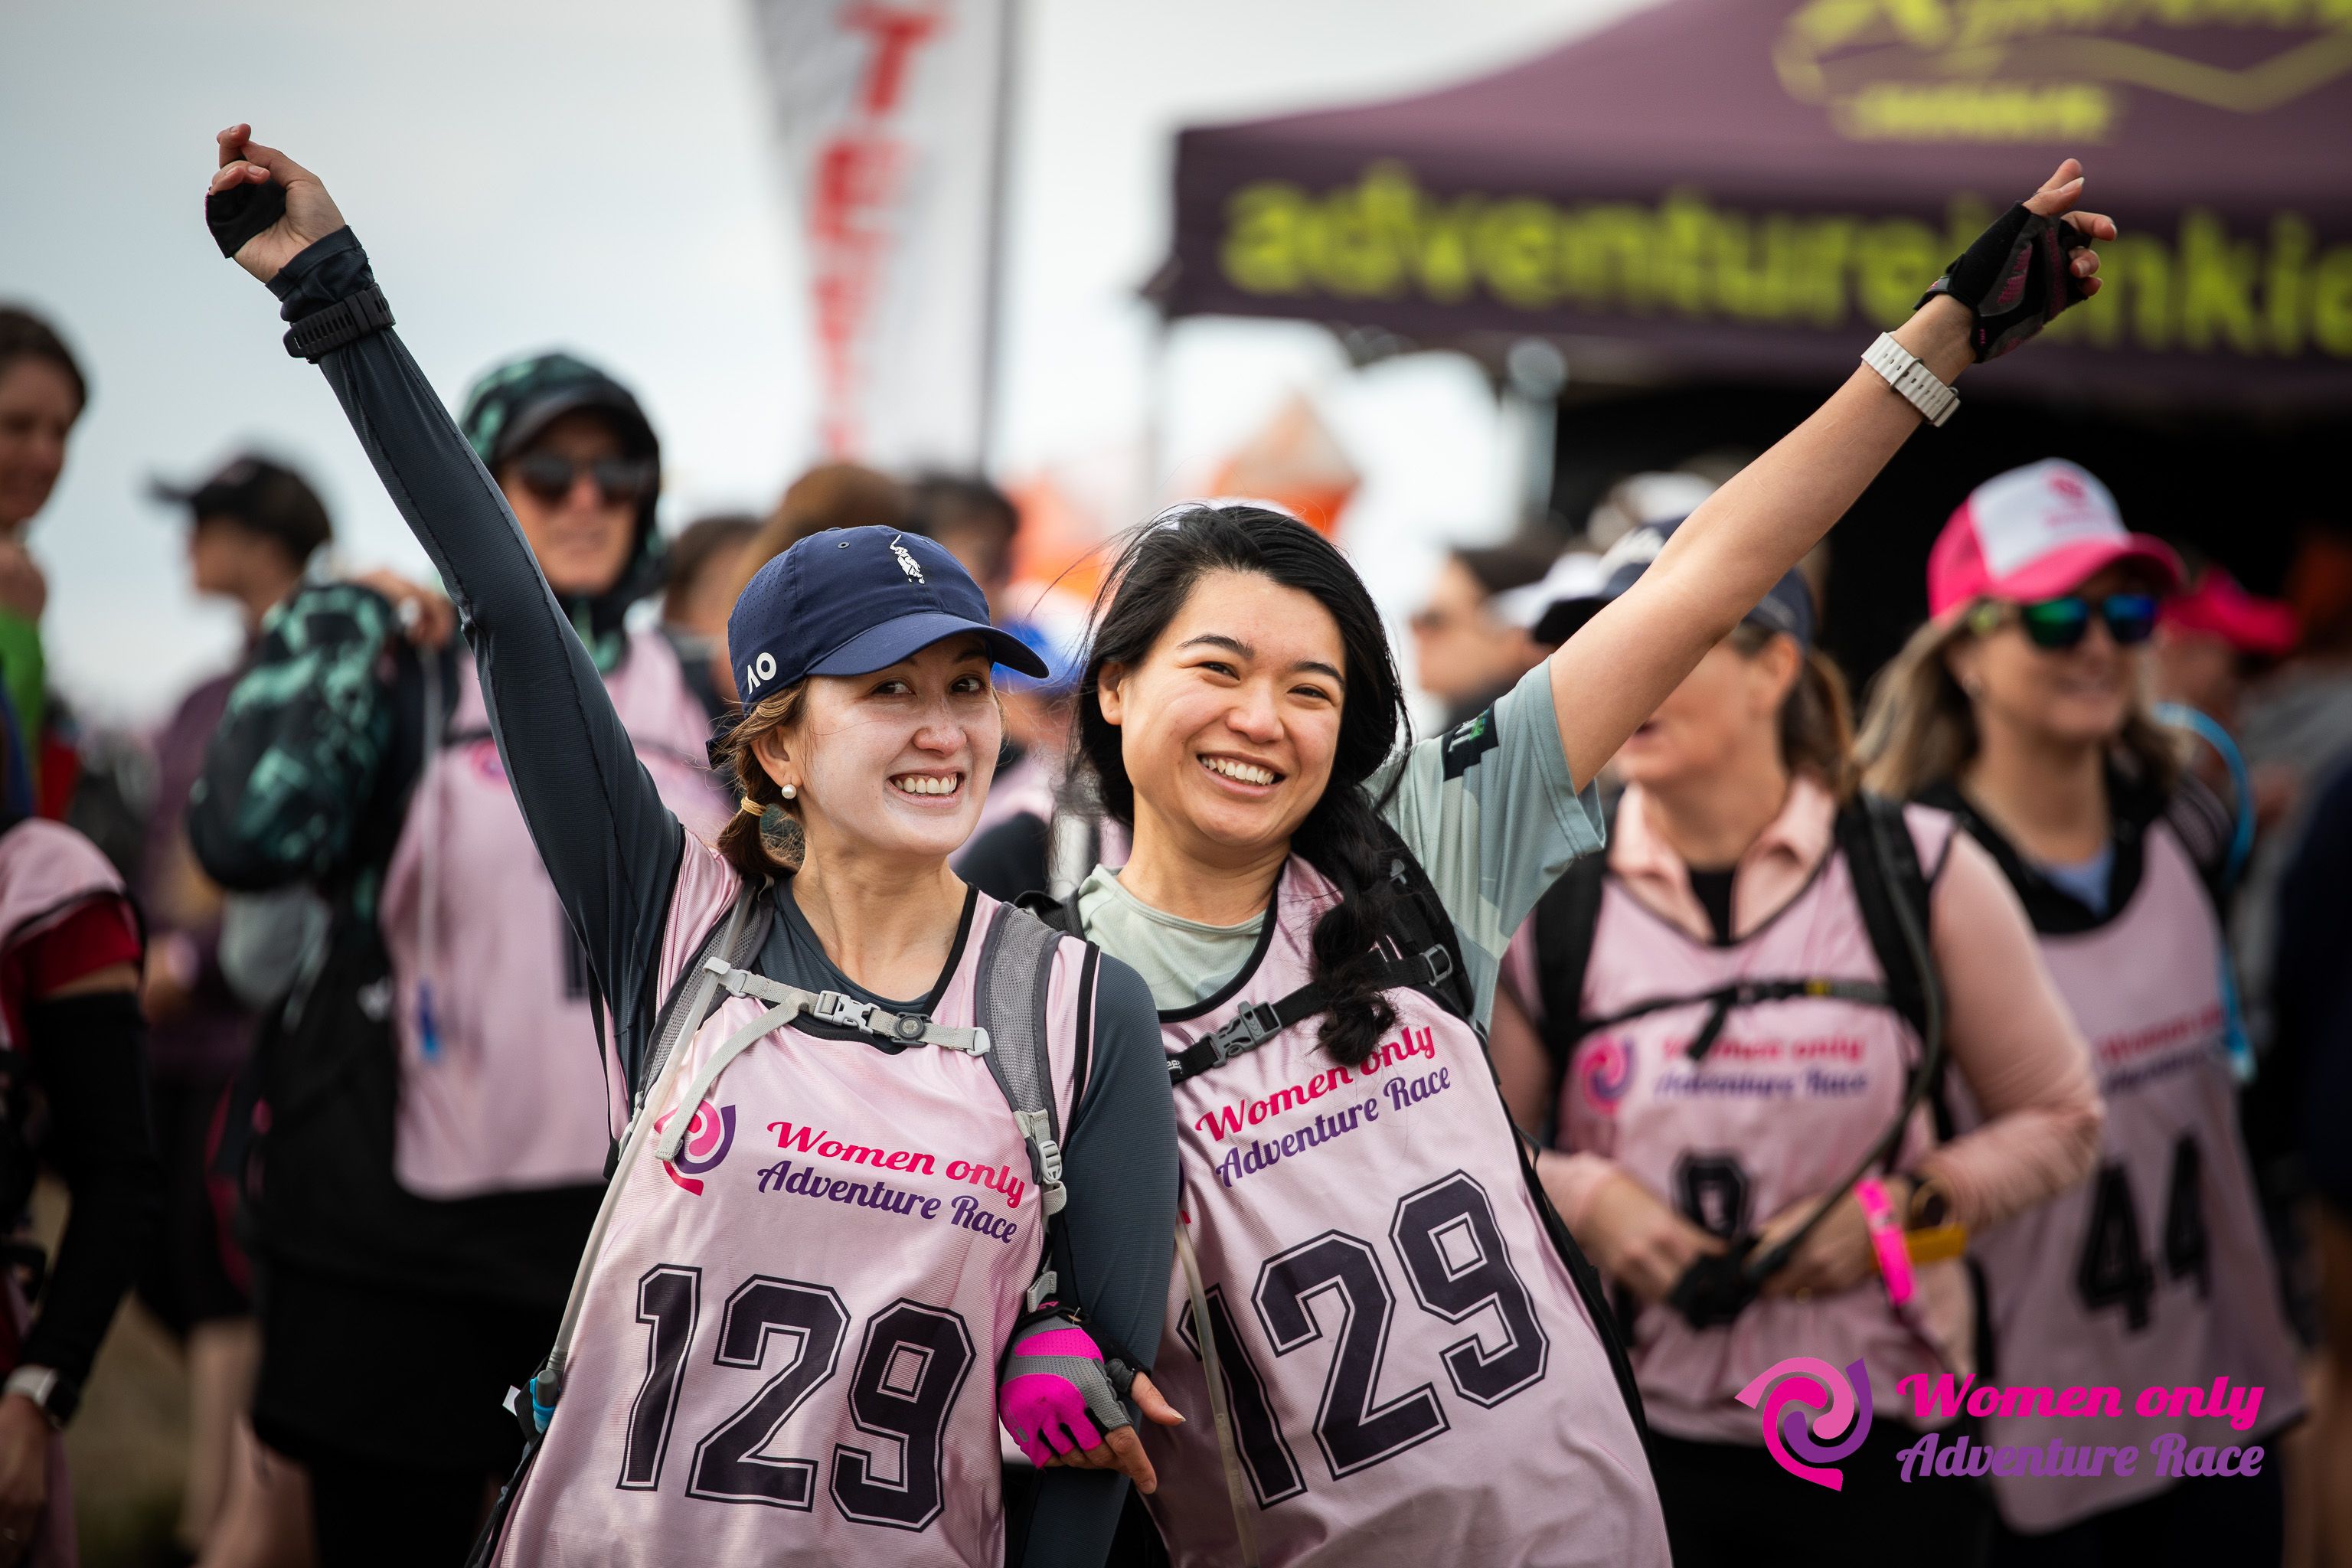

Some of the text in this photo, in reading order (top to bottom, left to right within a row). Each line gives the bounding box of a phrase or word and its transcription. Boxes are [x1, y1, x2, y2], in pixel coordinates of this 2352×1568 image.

[1195, 1026, 1436, 1142] Women only
[1215, 1067, 1451, 1187] Adventure Race
[757, 1159, 1018, 1243] Adventure Race
[766, 1121, 1025, 1209] Women only
[2076, 1132, 2214, 1334] 44
[616, 1263, 977, 1532] 129
[1176, 1169, 1550, 1511] 129
